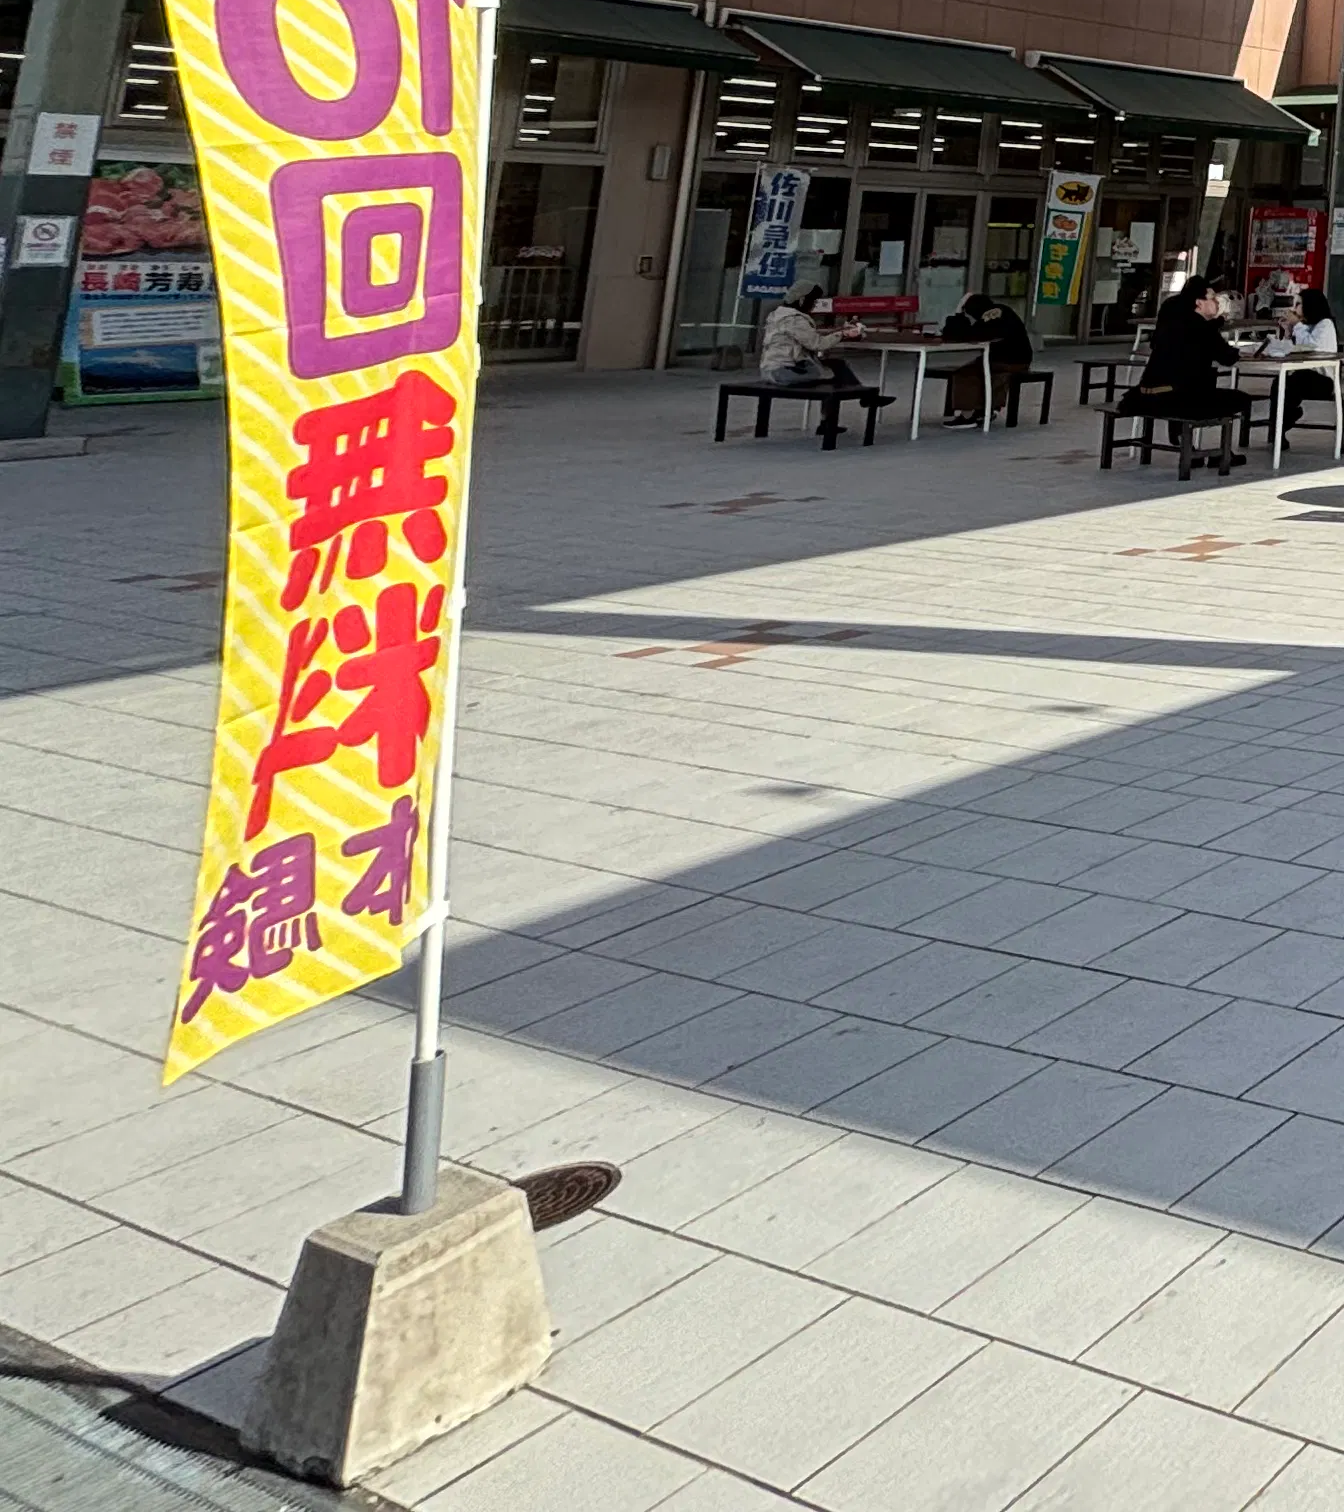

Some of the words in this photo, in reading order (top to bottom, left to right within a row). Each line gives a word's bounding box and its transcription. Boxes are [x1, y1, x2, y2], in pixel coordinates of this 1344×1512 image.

[759, 172, 801, 276] 佐川急便
[82, 271, 215, 292] 長崎芳寿
